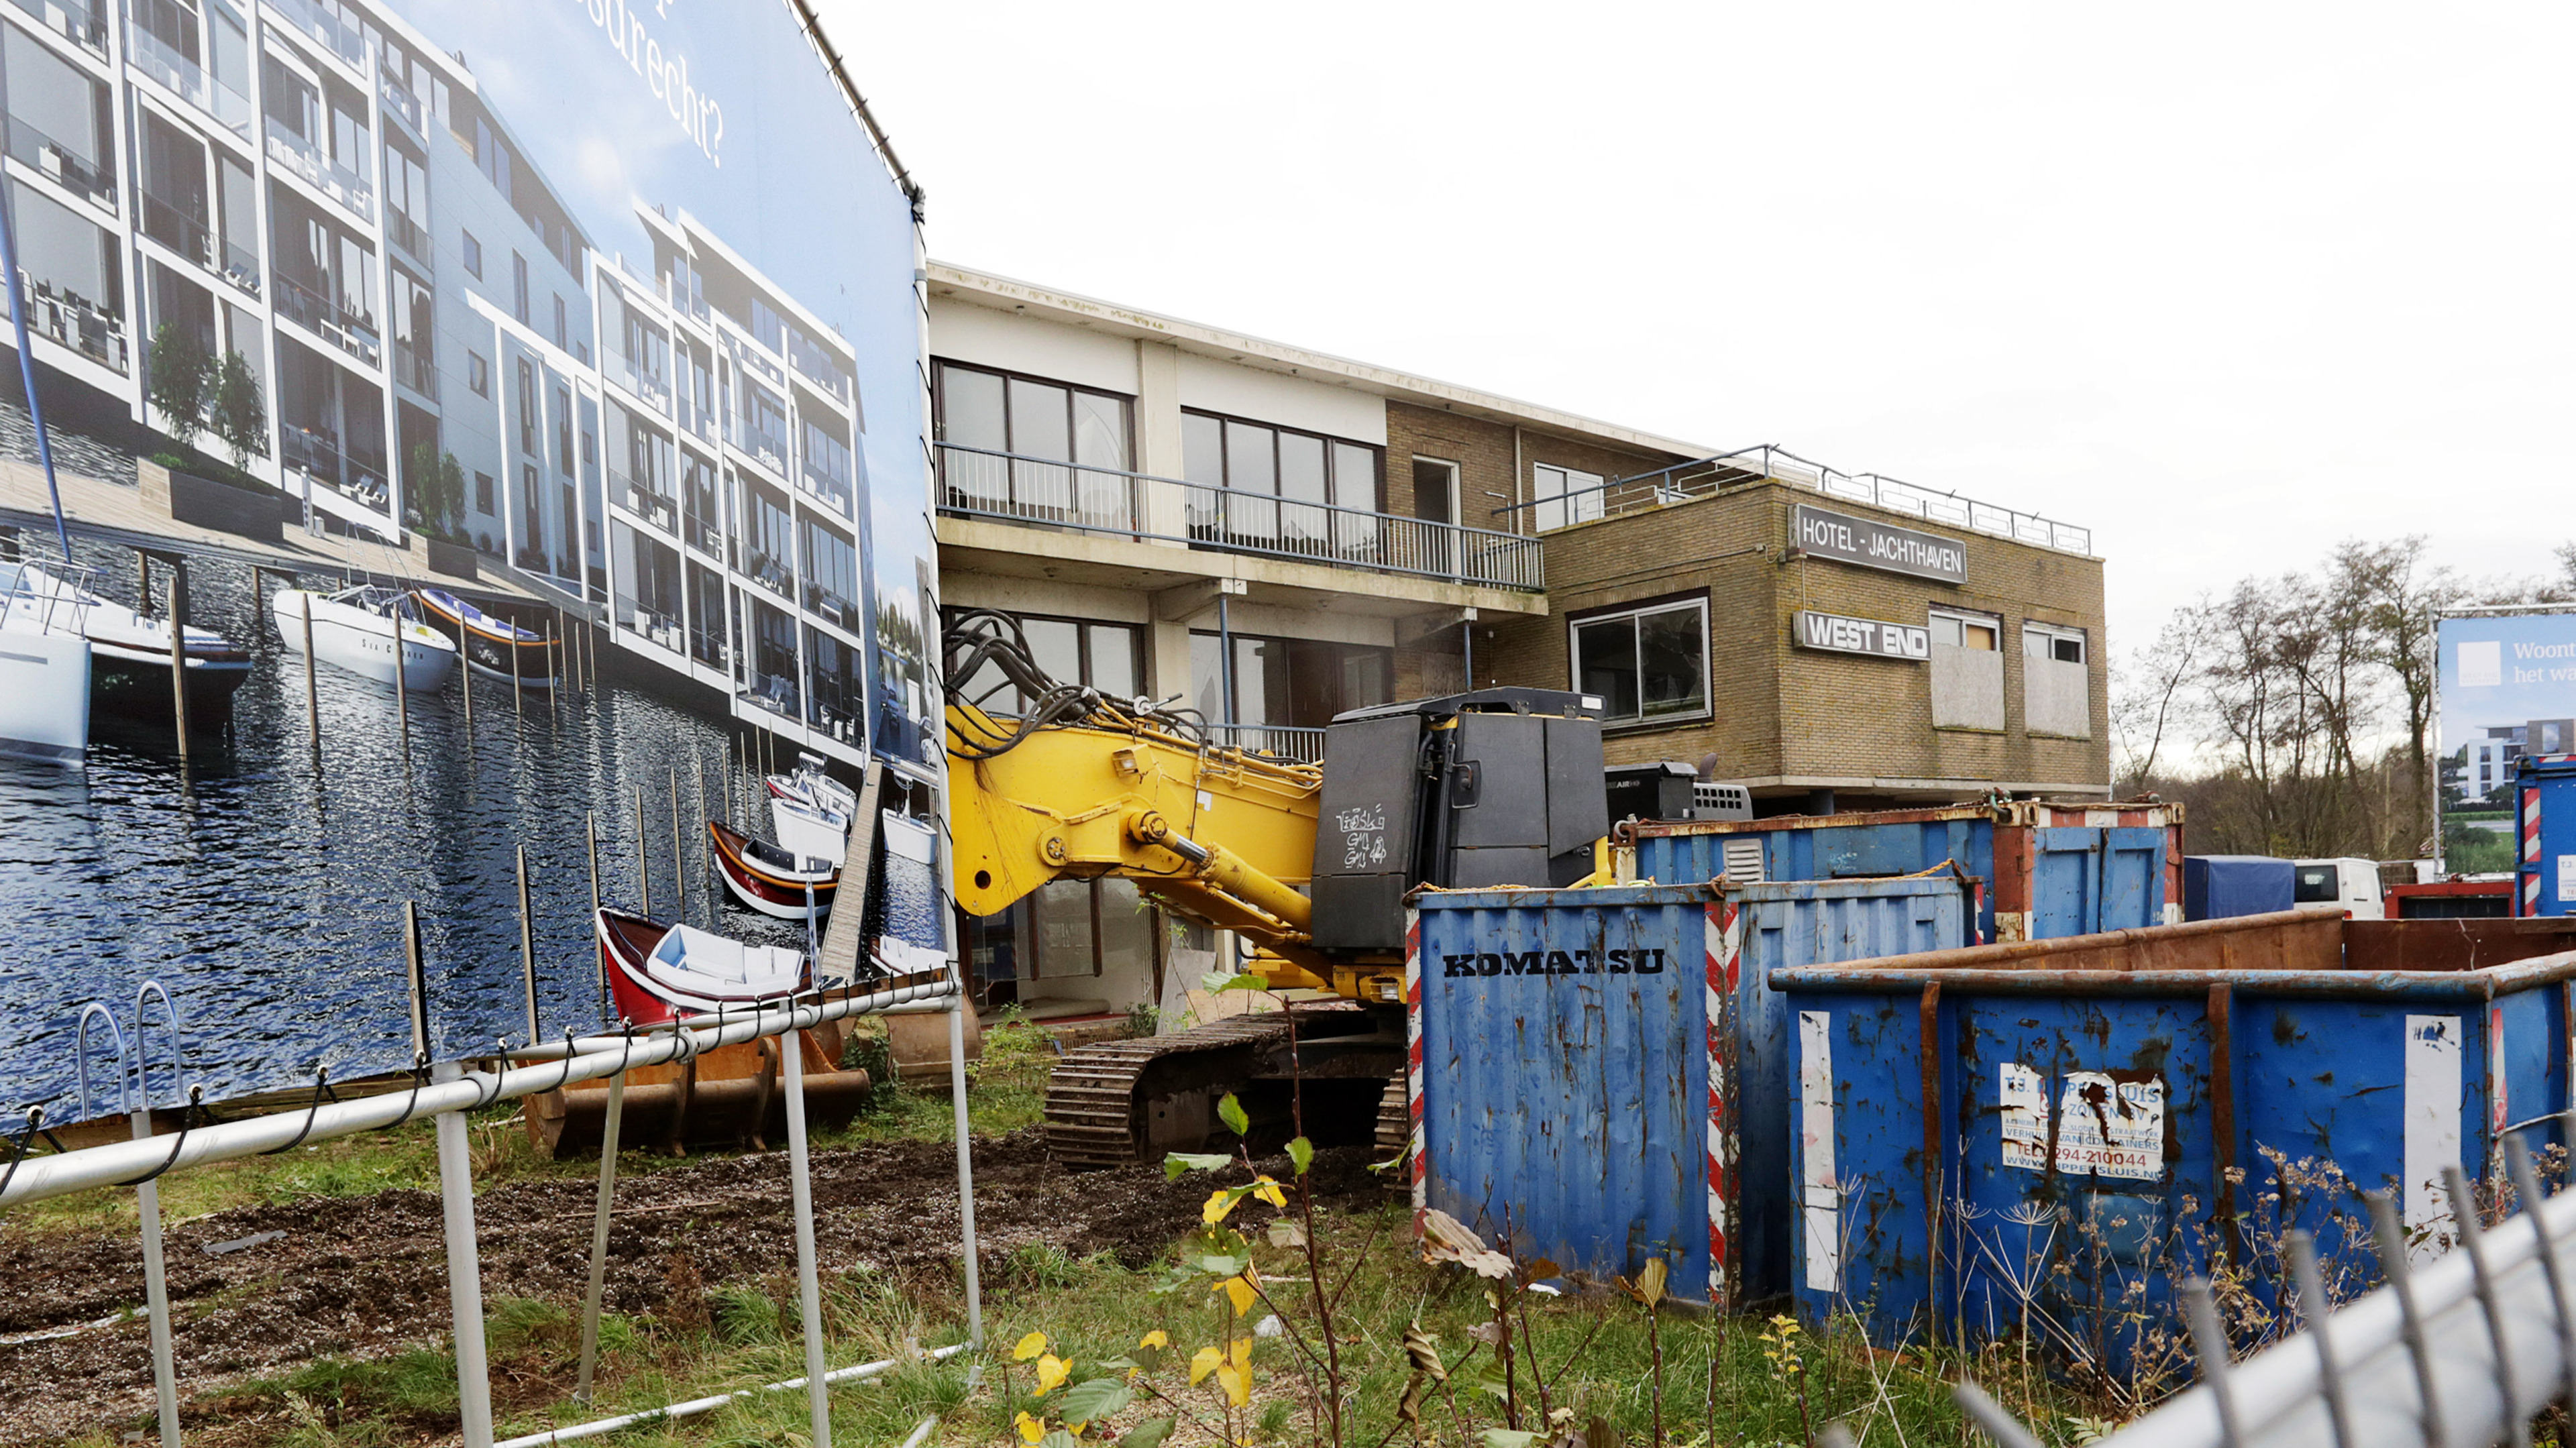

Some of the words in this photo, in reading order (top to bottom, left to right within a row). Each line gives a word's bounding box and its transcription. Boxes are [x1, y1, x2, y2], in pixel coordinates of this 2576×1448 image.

[574, 0, 722, 168] drecht?
[1803, 516, 1857, 553] HOTEL
[1868, 532, 1962, 573] JACHTHAVEN
[1807, 614, 1876, 651] WEST
[1882, 624, 1928, 657] END
[2512, 642, 2576, 659] Woont
[2514, 665, 2544, 683] het
[1443, 948, 1665, 977] KOMATSU
